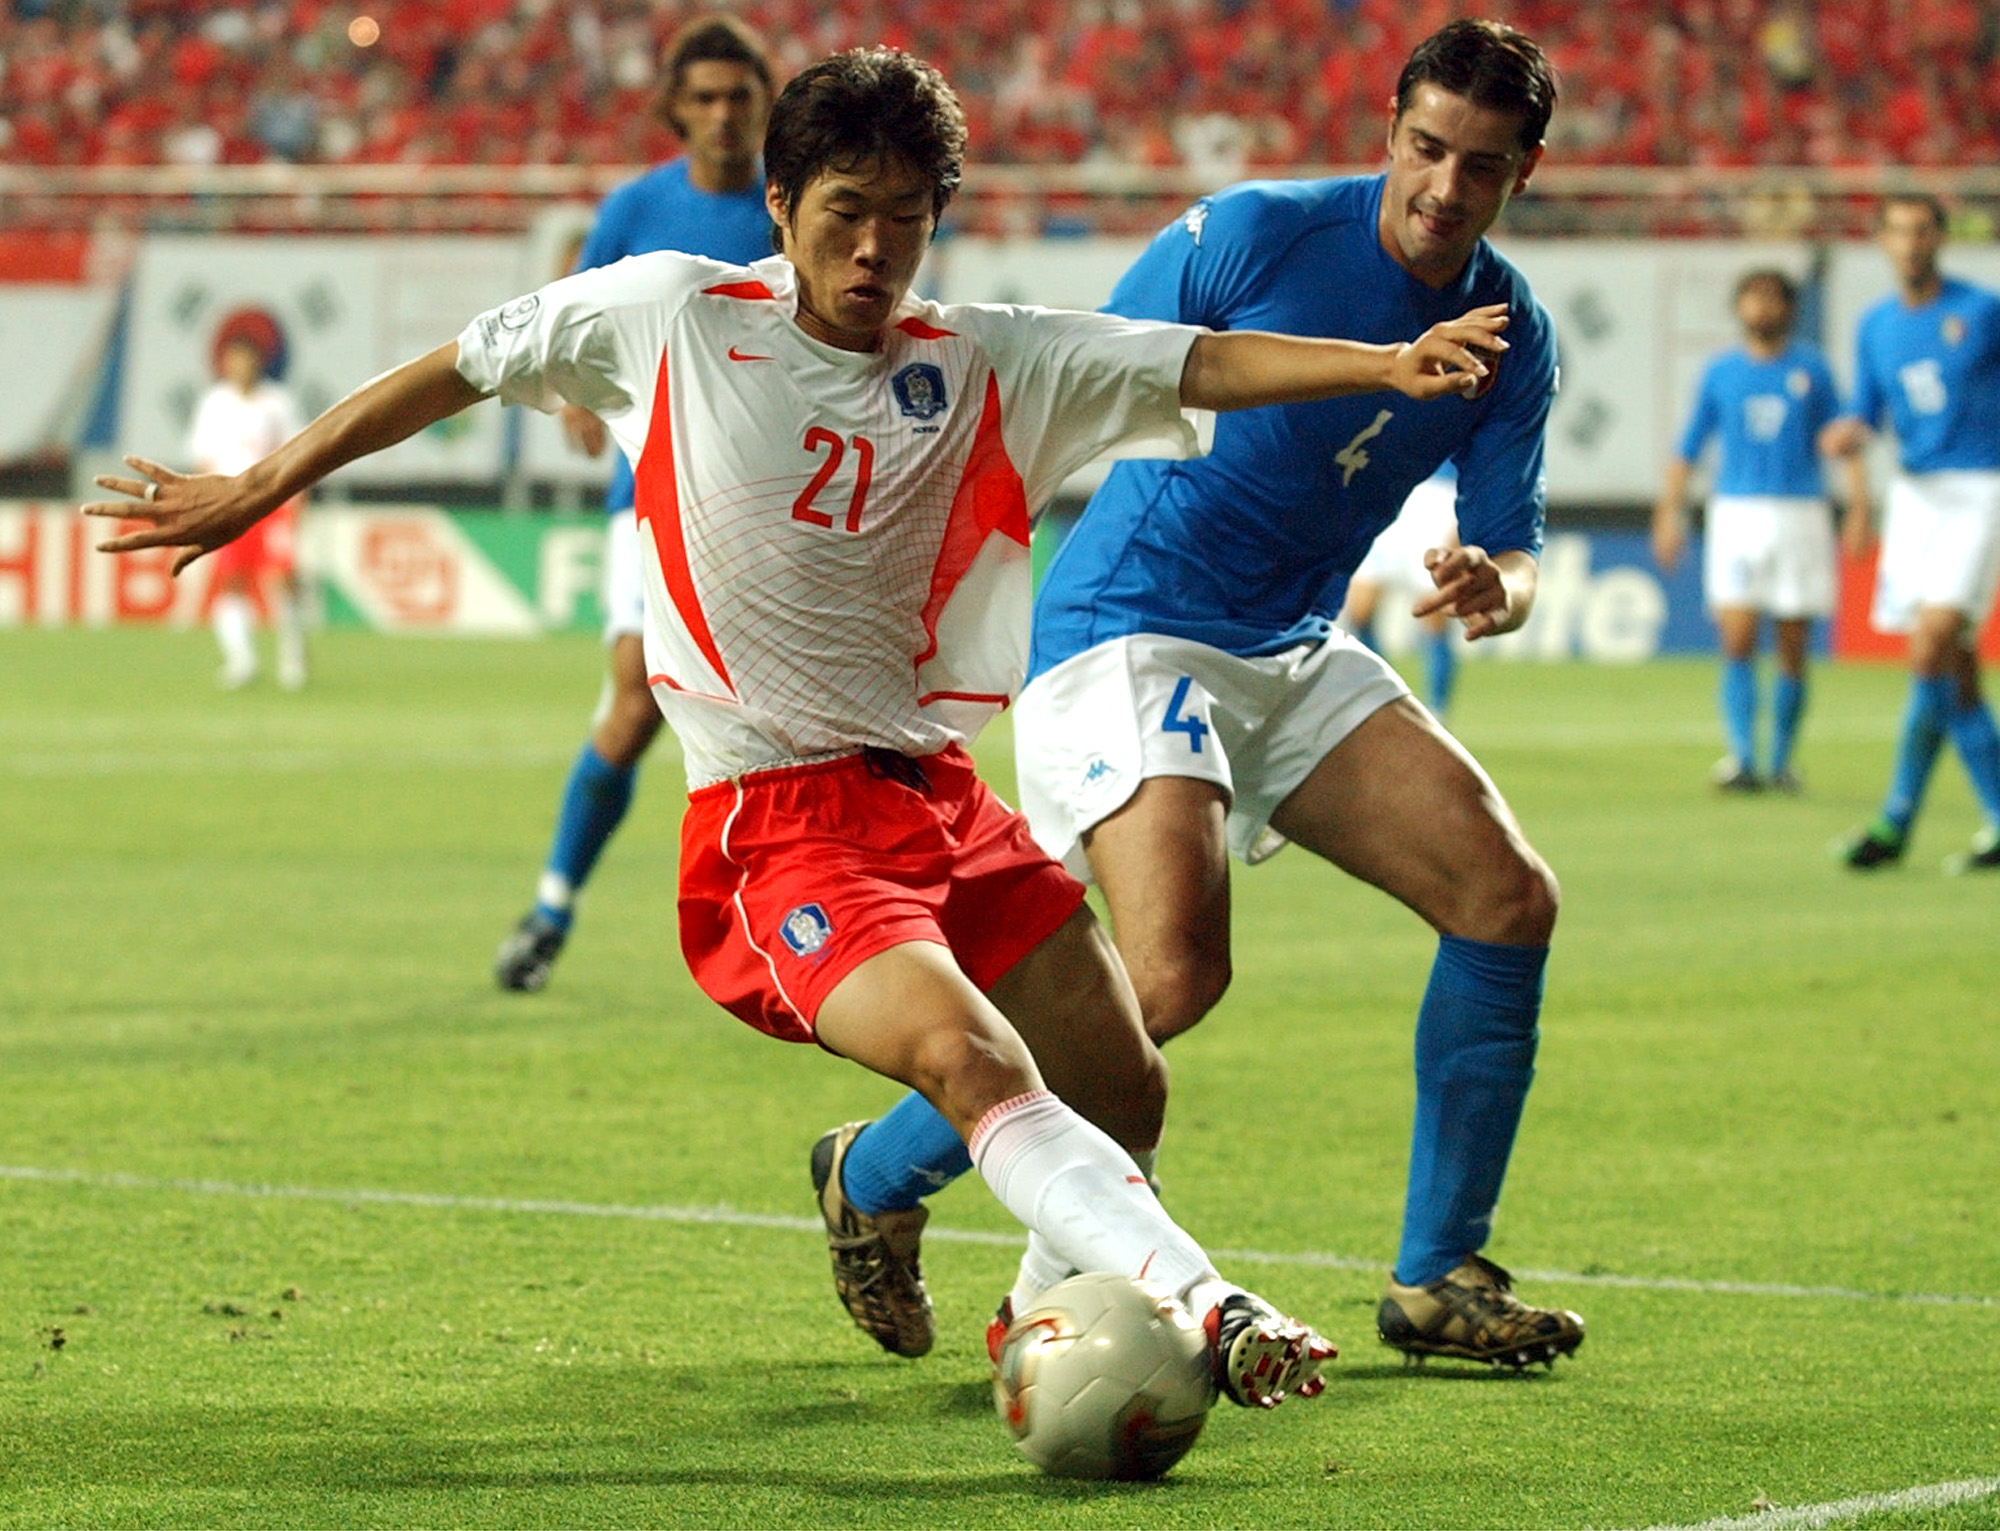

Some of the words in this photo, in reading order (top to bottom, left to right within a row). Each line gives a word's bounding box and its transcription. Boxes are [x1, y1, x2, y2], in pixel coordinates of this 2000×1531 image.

[791, 426, 875, 533] 21
[1334, 409, 1394, 487] 4
[1161, 676, 1208, 754] 4
